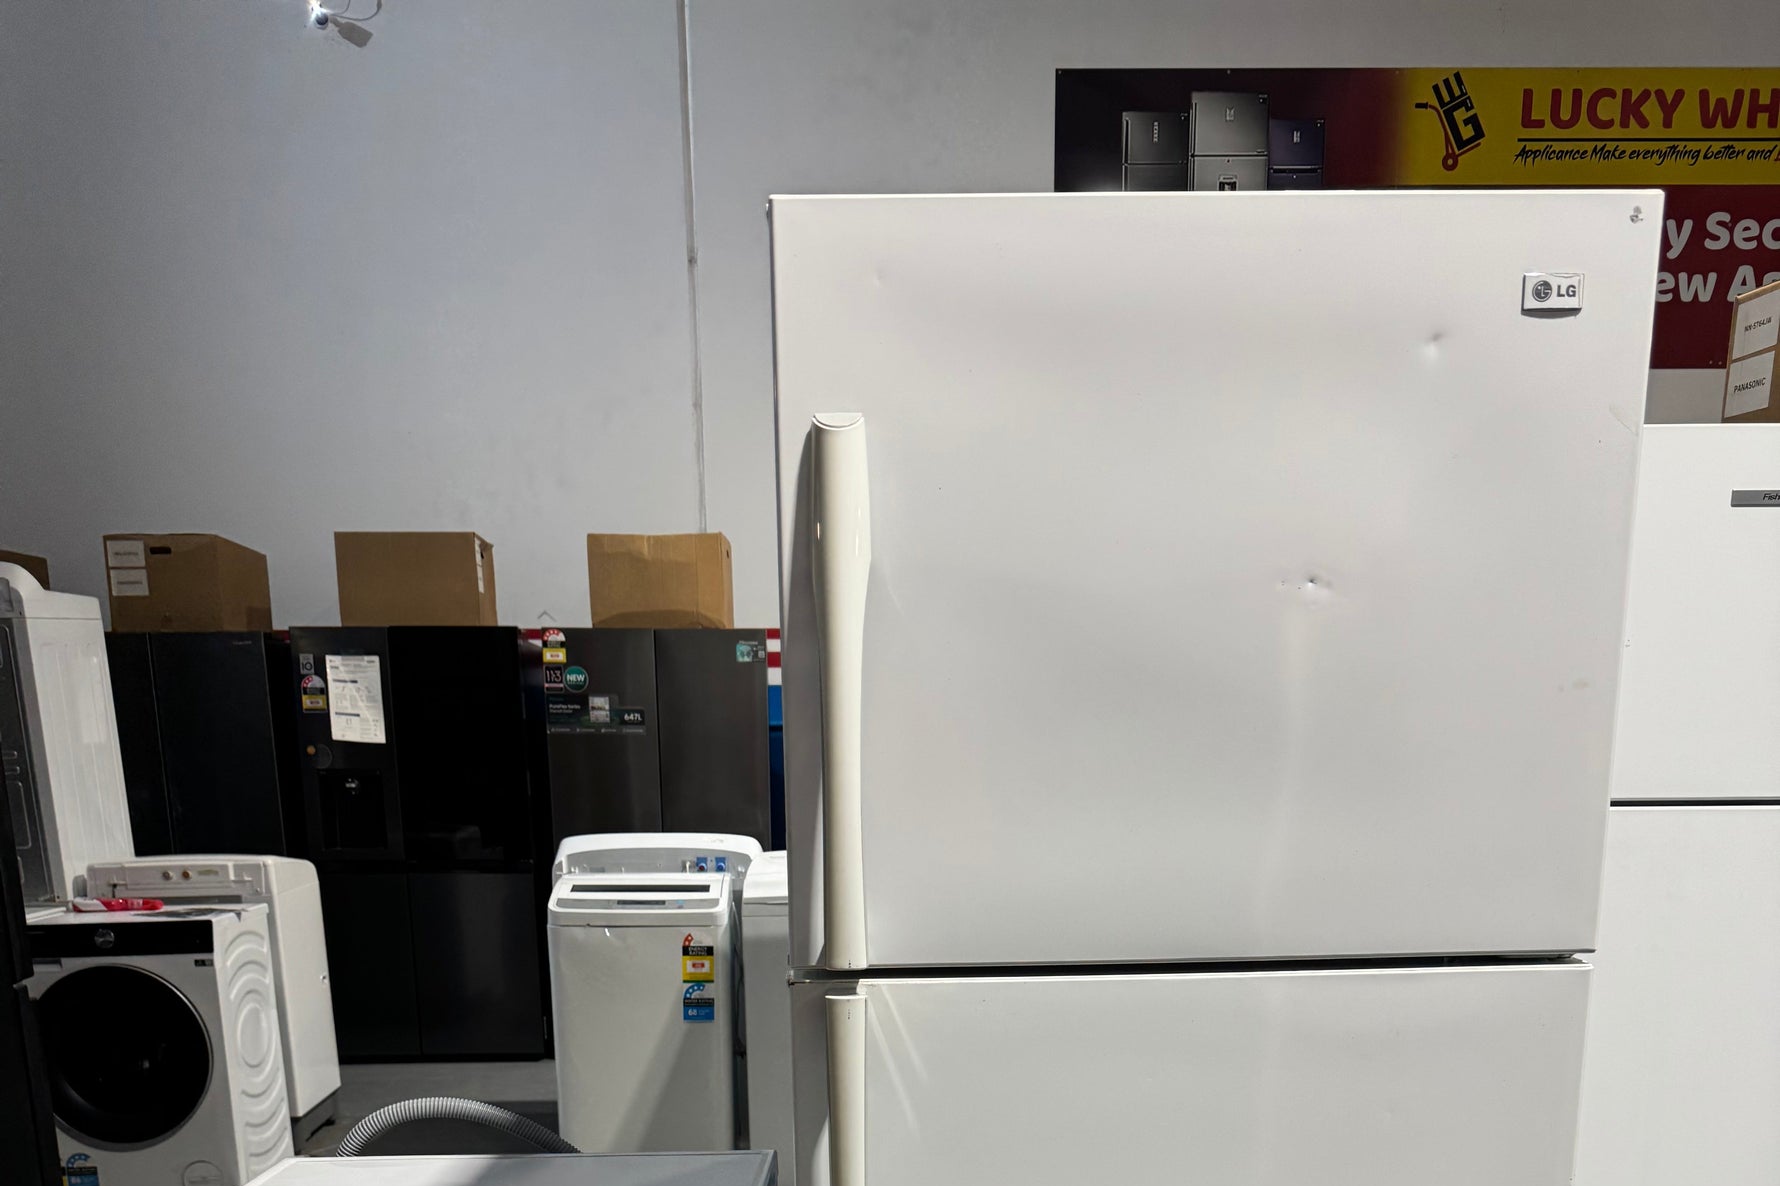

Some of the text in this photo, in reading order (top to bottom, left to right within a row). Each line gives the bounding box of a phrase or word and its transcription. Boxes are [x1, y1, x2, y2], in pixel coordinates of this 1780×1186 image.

[1521, 88, 1780, 130] LUCKY WH
[1512, 144, 1587, 166] Applicance
[1589, 144, 1627, 163] Make
[1628, 144, 1701, 167] everything
[1703, 144, 1745, 161] better
[1746, 144, 1774, 162] and
[1556, 284, 1577, 298] LG
[1733, 377, 1767, 394] PANASONIC
[566, 673, 585, 682] NEW
[624, 713, 642, 721] 647L
